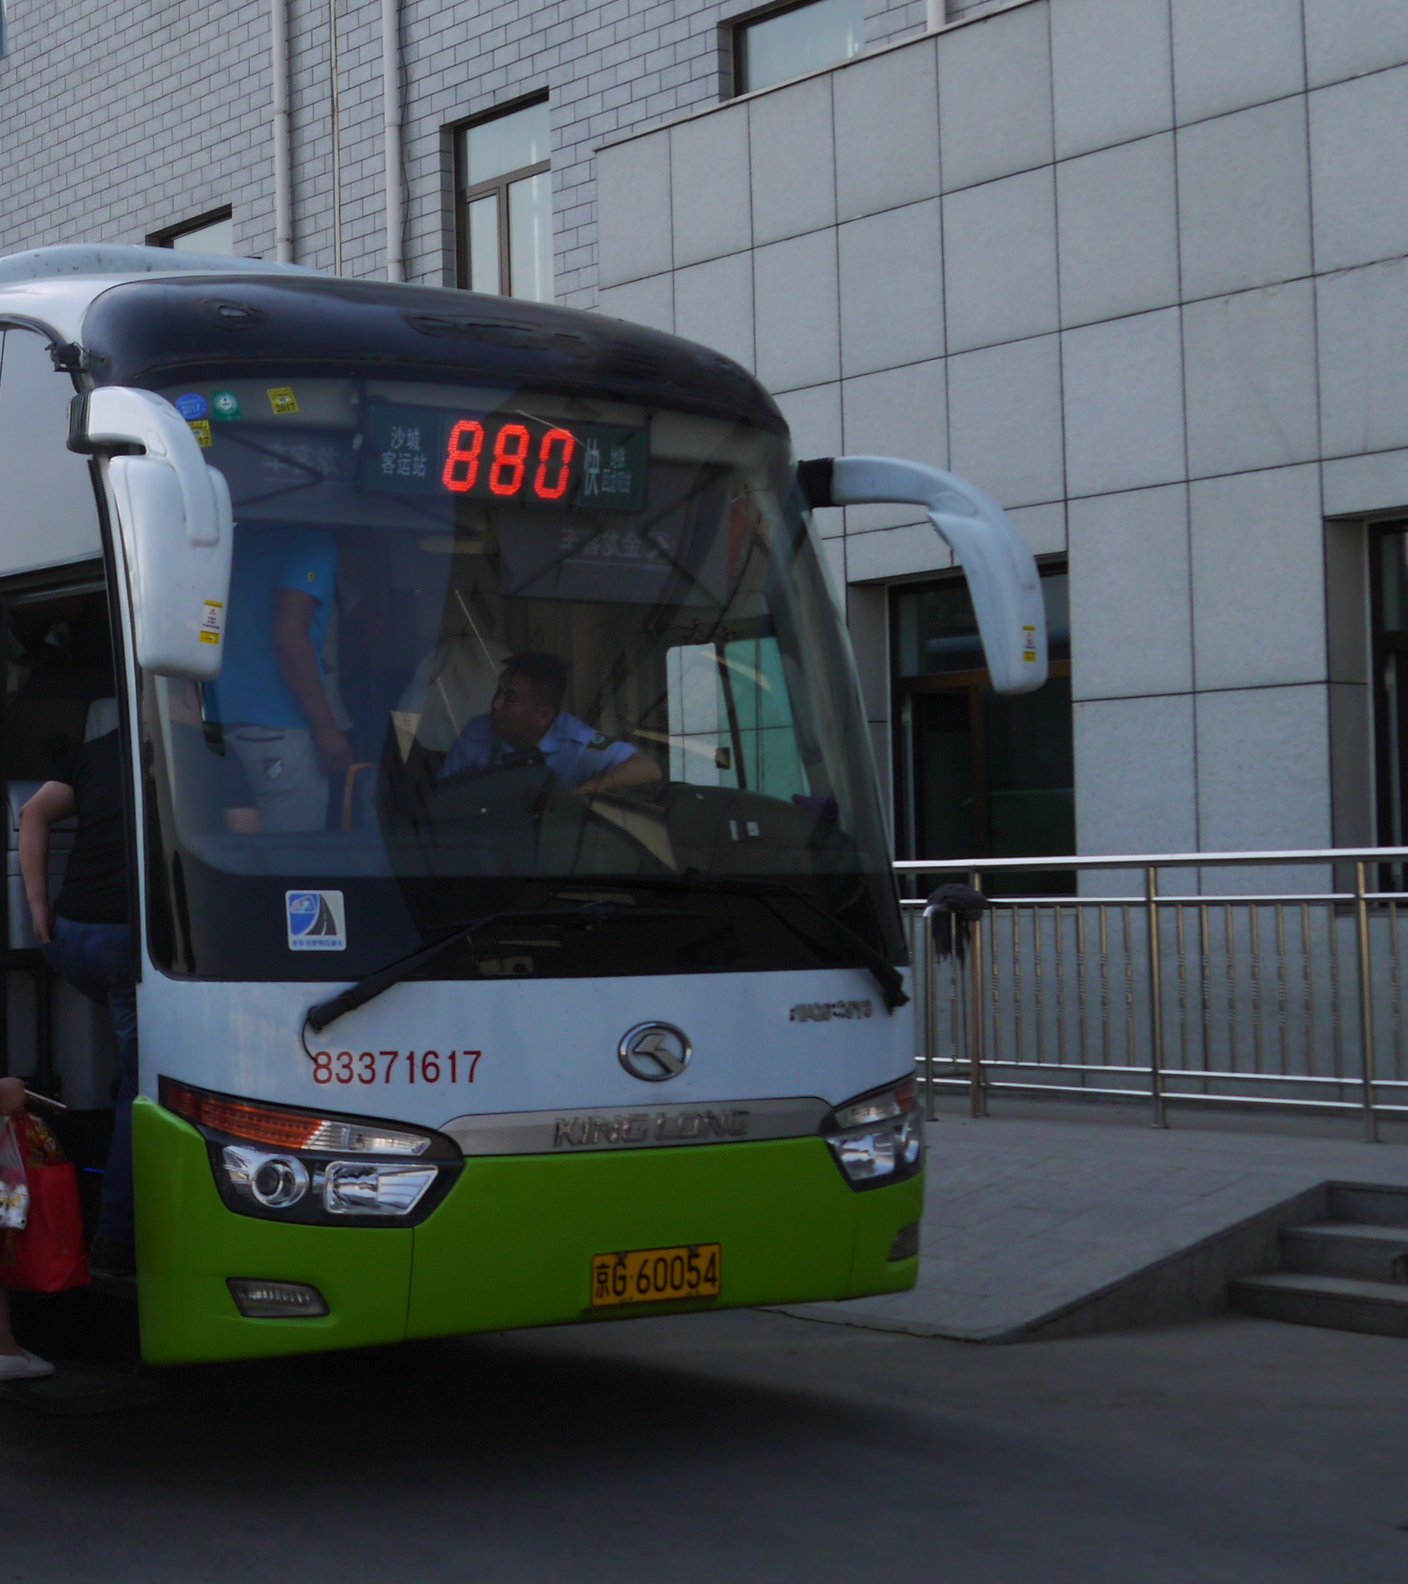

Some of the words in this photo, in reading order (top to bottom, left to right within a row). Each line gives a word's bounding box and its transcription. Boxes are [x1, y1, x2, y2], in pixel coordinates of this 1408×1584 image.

[275, 402, 296, 413] 2017
[390, 425, 421, 451] 沙城
[381, 450, 428, 478] 客运站
[442, 418, 574, 500] 880
[312, 1048, 483, 1086] 83371617
[554, 1113, 650, 1147] KING
[654, 1109, 750, 1142] LONG
